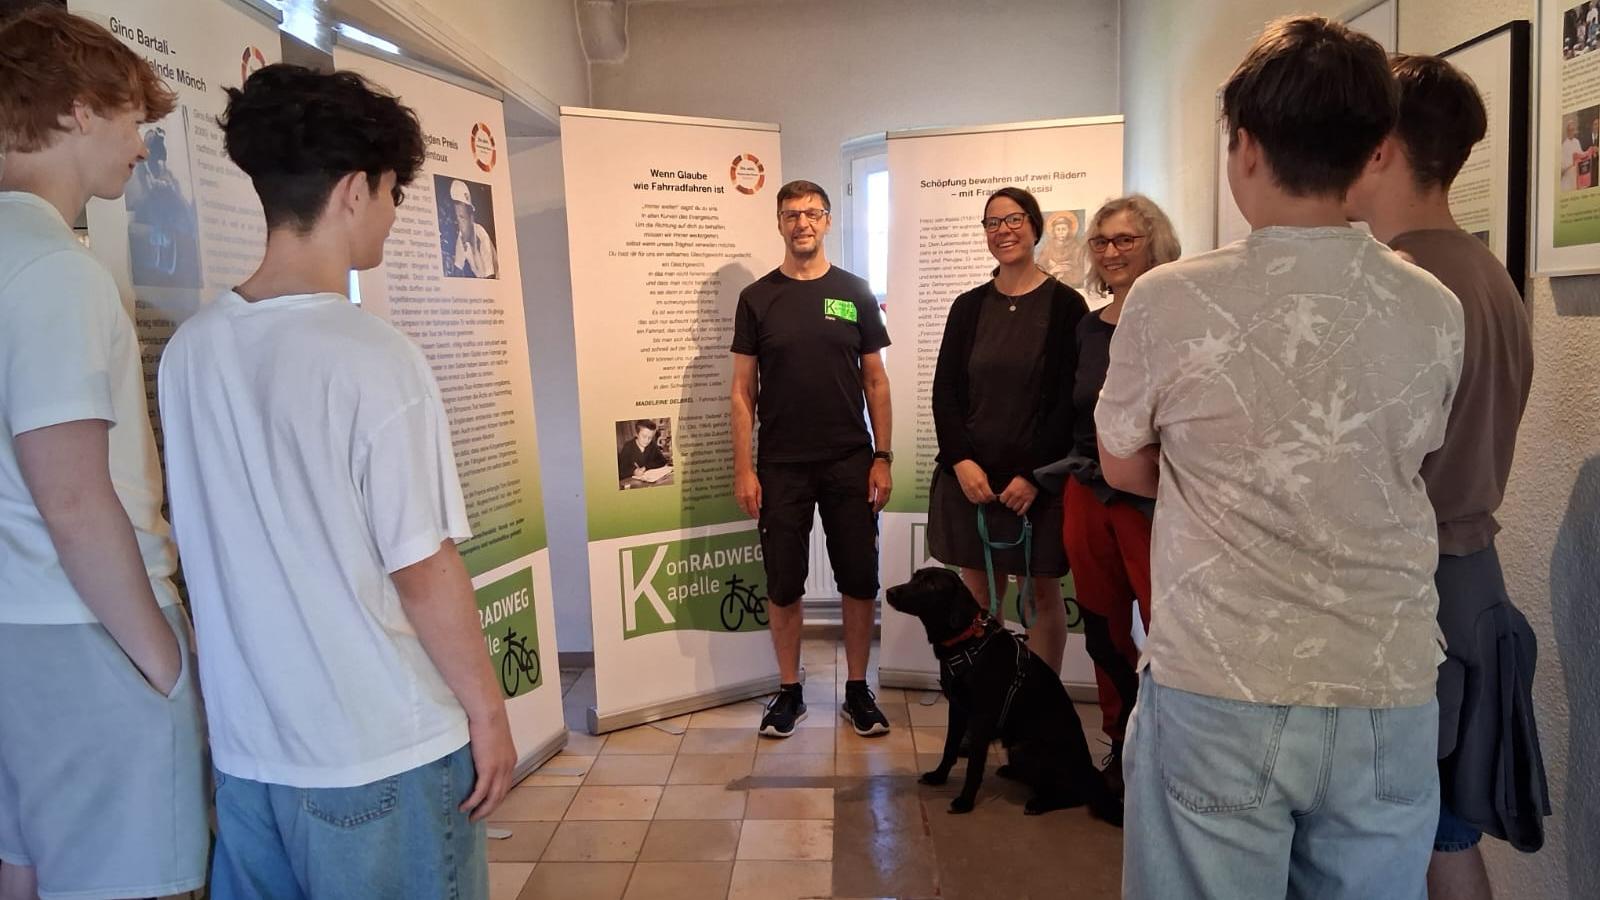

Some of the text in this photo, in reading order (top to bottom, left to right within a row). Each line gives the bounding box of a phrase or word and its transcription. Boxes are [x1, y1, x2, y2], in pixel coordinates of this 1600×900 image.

[109, 16, 134, 40] Gino
[136, 28, 169, 55] Bartali
[176, 68, 207, 92] Mönch
[441, 136, 459, 150] Preis
[425, 150, 448, 163] entoux
[650, 168, 708, 181] Wenn Glaube
[920, 170, 1087, 188] Schöpfung bewahren auf zwei Rädern
[633, 181, 725, 194] wie Fahrradfahren ist
[958, 189, 974, 198] mit
[976, 187, 1000, 197] Fran
[1025, 184, 1053, 194] Assisi
[635, 398, 668, 407] MADELEINE
[622, 543, 677, 632] K
[667, 575, 720, 604] apelle
[478, 587, 529, 630] RADWEG
